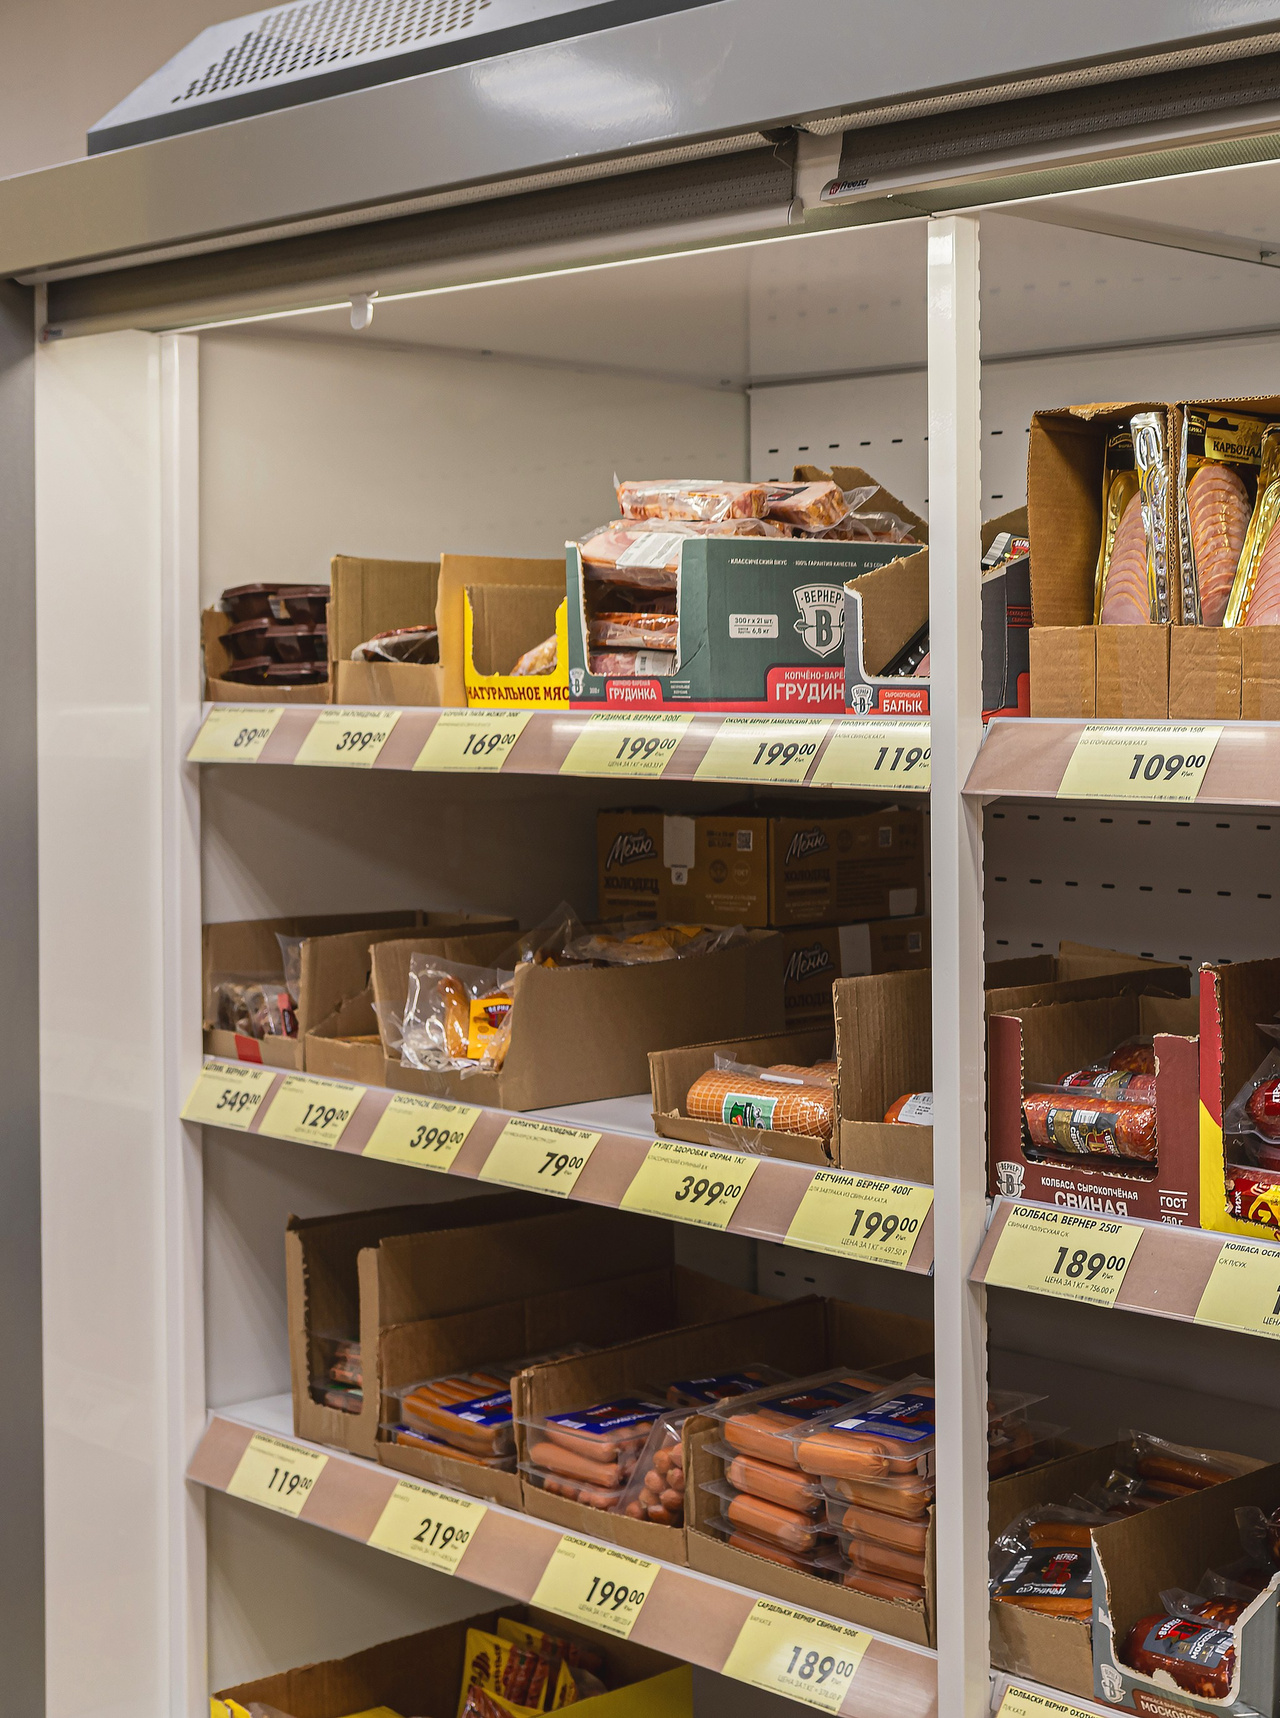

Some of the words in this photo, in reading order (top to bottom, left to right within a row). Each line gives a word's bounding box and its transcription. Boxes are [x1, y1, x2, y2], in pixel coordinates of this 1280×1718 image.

[1213, 440, 1261, 458] КАРБОНАД
[803, 590, 842, 604] ВЕРНЕР
[467, 686, 541, 702] НАТУРАЛЬНОЕ
[609, 688, 657, 703] ГРУДИНКА
[776, 683, 845, 703] ГРУДИН
[592, 713, 632, 721] ГРУДИНКА
[883, 700, 922, 713] БАЛЫК
[234, 729, 257, 747] 89
[337, 732, 372, 751] 399
[463, 734, 501, 755] 169
[501, 734, 516, 744] 00
[615, 737, 660, 760] 199
[661, 739, 676, 750] 00
[753, 742, 799, 765] 199
[799, 743, 816, 755] 00
[873, 747, 923, 771] 119
[1129, 754, 1185, 781] 109
[1186, 754, 1206, 768] 00
[217, 1089, 251, 1112] 549
[300, 1103, 336, 1129] 129
[410, 1125, 450, 1151] 399
[450, 1131, 464, 1144] 00
[654, 1141, 672, 1151] РУЛЕТ
[673, 1144, 708, 1158] ЗДОРОВАЯ
[709, 1150, 732, 1162] ФЕРМА
[537, 1152, 569, 1176] 79
[570, 1157, 583, 1169] 00
[675, 1175, 724, 1206] 399
[724, 1183, 741, 1198] 00
[815, 1171, 854, 1187] ВЕТЧИНА
[856, 1178, 889, 1192] ВЕРНЕР
[891, 1185, 913, 1196] 400Г
[1041, 1176, 1076, 1190] КОЛБАСА
[1076, 1182, 1138, 1200] СЫРОКОПЧЁНАЯ
[1054, 1191, 1128, 1216] СВИНАЯ
[1160, 1196, 1188, 1210] ГОСТ
[849, 1209, 900, 1242] 199
[900, 1217, 919, 1234] 00
[1012, 1206, 1058, 1224] КОЛБАСА
[1060, 1214, 1097, 1230] ВЕРНЕР
[1098, 1222, 1122, 1234] 250Г
[841, 1237, 857, 1247] ЦЕНА
[1225, 1243, 1259, 1254] КОЛБАСА
[1052, 1246, 1106, 1281] 189
[1106, 1256, 1126, 1272] 00
[1044, 1275, 1062, 1286] ЦЕНА
[268, 1467, 301, 1496] 119
[300, 1477, 313, 1490] 00
[413, 1518, 455, 1550] 219
[455, 1528, 470, 1544] 00
[584, 1576, 629, 1611] 199
[629, 1589, 645, 1606] 00
[757, 1601, 793, 1617] САРДЕЛЬКИ
[793, 1612, 816, 1623] ВЕРНЕР
[816, 1619, 842, 1633] СВИНЫЕ
[786, 1645, 836, 1684] 189
[836, 1660, 854, 1678] 00
[1008, 1688, 1044, 1705] КОЛБАСКИ
[1044, 1700, 1069, 1713] ВЕРНЕР
